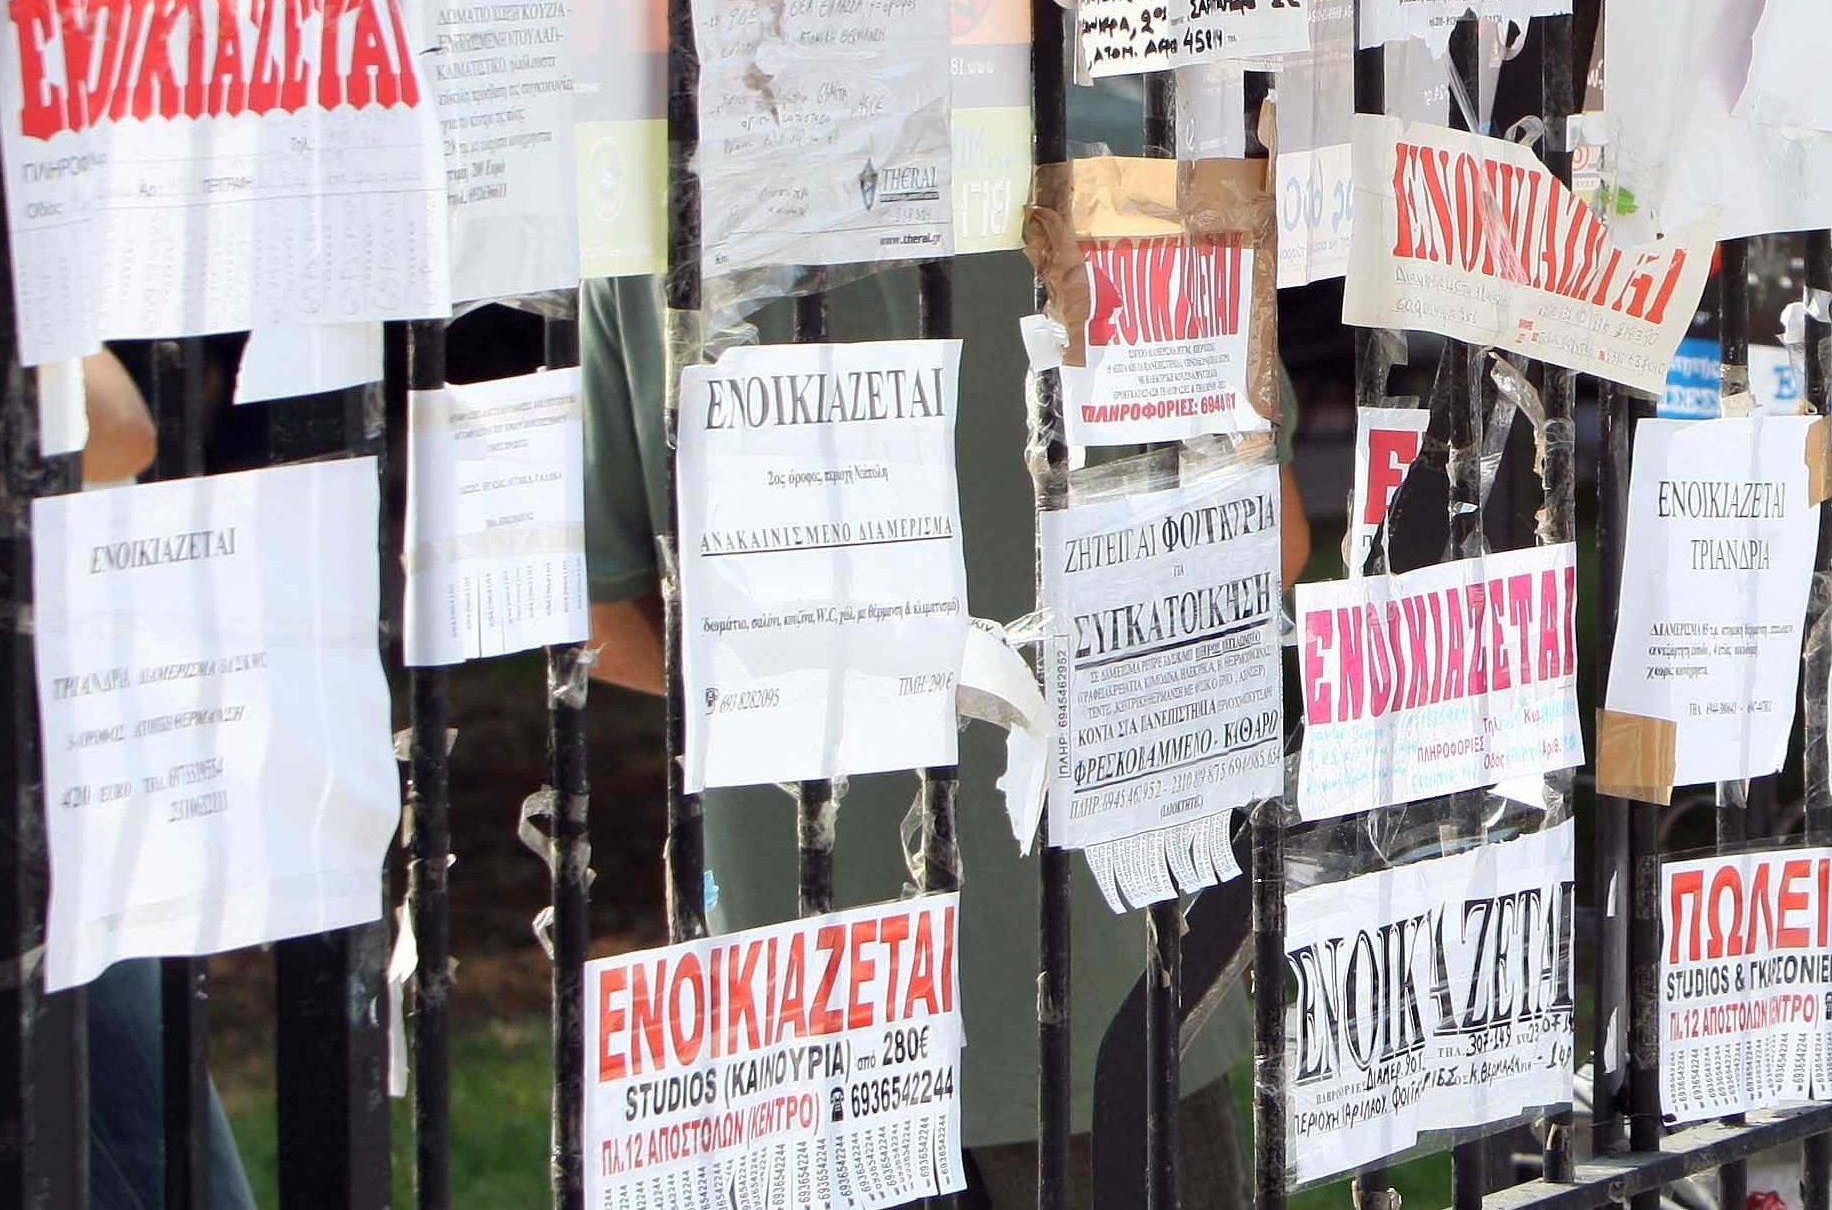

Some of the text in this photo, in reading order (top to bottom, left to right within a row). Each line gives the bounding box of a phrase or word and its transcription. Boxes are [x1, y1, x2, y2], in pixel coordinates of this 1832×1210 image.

[704, 368, 946, 431] ΕΝΟΙΚΙΑΖΕΤΑΙ
[1658, 481, 1787, 519] ΕΝΟΙΚΙΑΖΕΤΑΙ
[91, 528, 237, 575] ΕΝΟΙΚΙΑΖΕΤΑΙ
[700, 514, 953, 552] ΑΝΑΚΑΙΝΙΣΜΕΝΟ ΔΙΑΜΕΡΙΣΜΑ
[1691, 539, 1771, 572] ΤΡΙΑΝΔΡΙΑ
[1074, 570, 1271, 658] ΣΥΓΚΑΤΟΙΚΗΣΗ
[1305, 566, 1575, 726] ΕΝΟΙΚΙΑΖΕΤΑΙ
[1417, 734, 1485, 764] ΠΛΗΡΟΦΟΡΙΕΣ
[600, 905, 956, 1083] ΕΝΟΙΚΙΑΖΕΤΑΙ
[1666, 964, 1730, 1002] STUDIOS
[1735, 963, 1745, 990] &
[1702, 1000, 1768, 1035] ΑΠΟΣΤΟΛΩΝ
[625, 1070, 717, 1122] STUDIOS
[724, 1038, 853, 1110] (ΚΑΙΝΟΥΡΙΑ)
[882, 1023, 931, 1067] 280€
[647, 1107, 746, 1167] ΑΠΟΣΤΟΛΩΝ
[746, 1090, 821, 1142] (ΚΕΝΤΡΟ)
[851, 1064, 955, 1120] 6936542244
